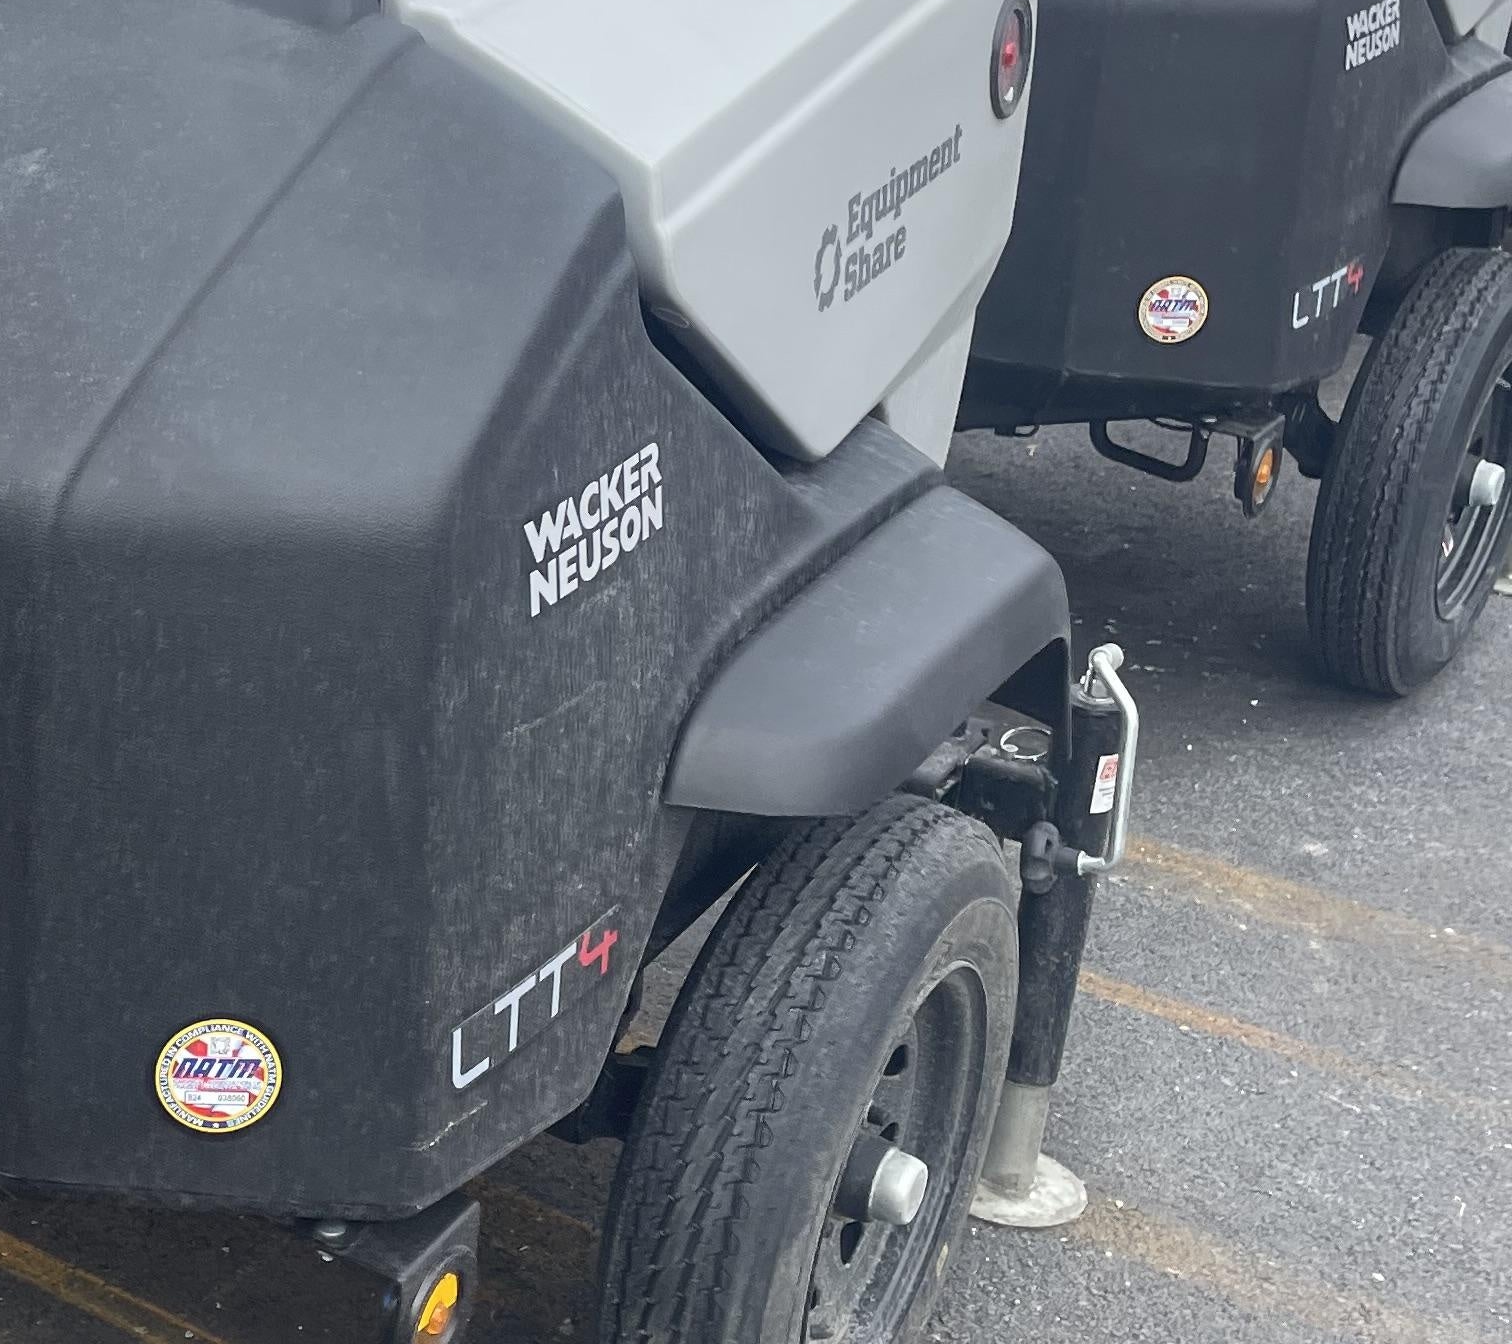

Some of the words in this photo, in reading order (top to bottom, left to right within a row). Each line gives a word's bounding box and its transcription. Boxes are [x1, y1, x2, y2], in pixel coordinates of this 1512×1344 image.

[1346, 20, 1400, 70] NEUSON
[847, 124, 963, 243] Equipment
[843, 224, 907, 302] Share
[523, 442, 663, 563] WACKER
[528, 485, 664, 617] NEUSON
[176, 1024, 244, 1048] COMPLIANCE
